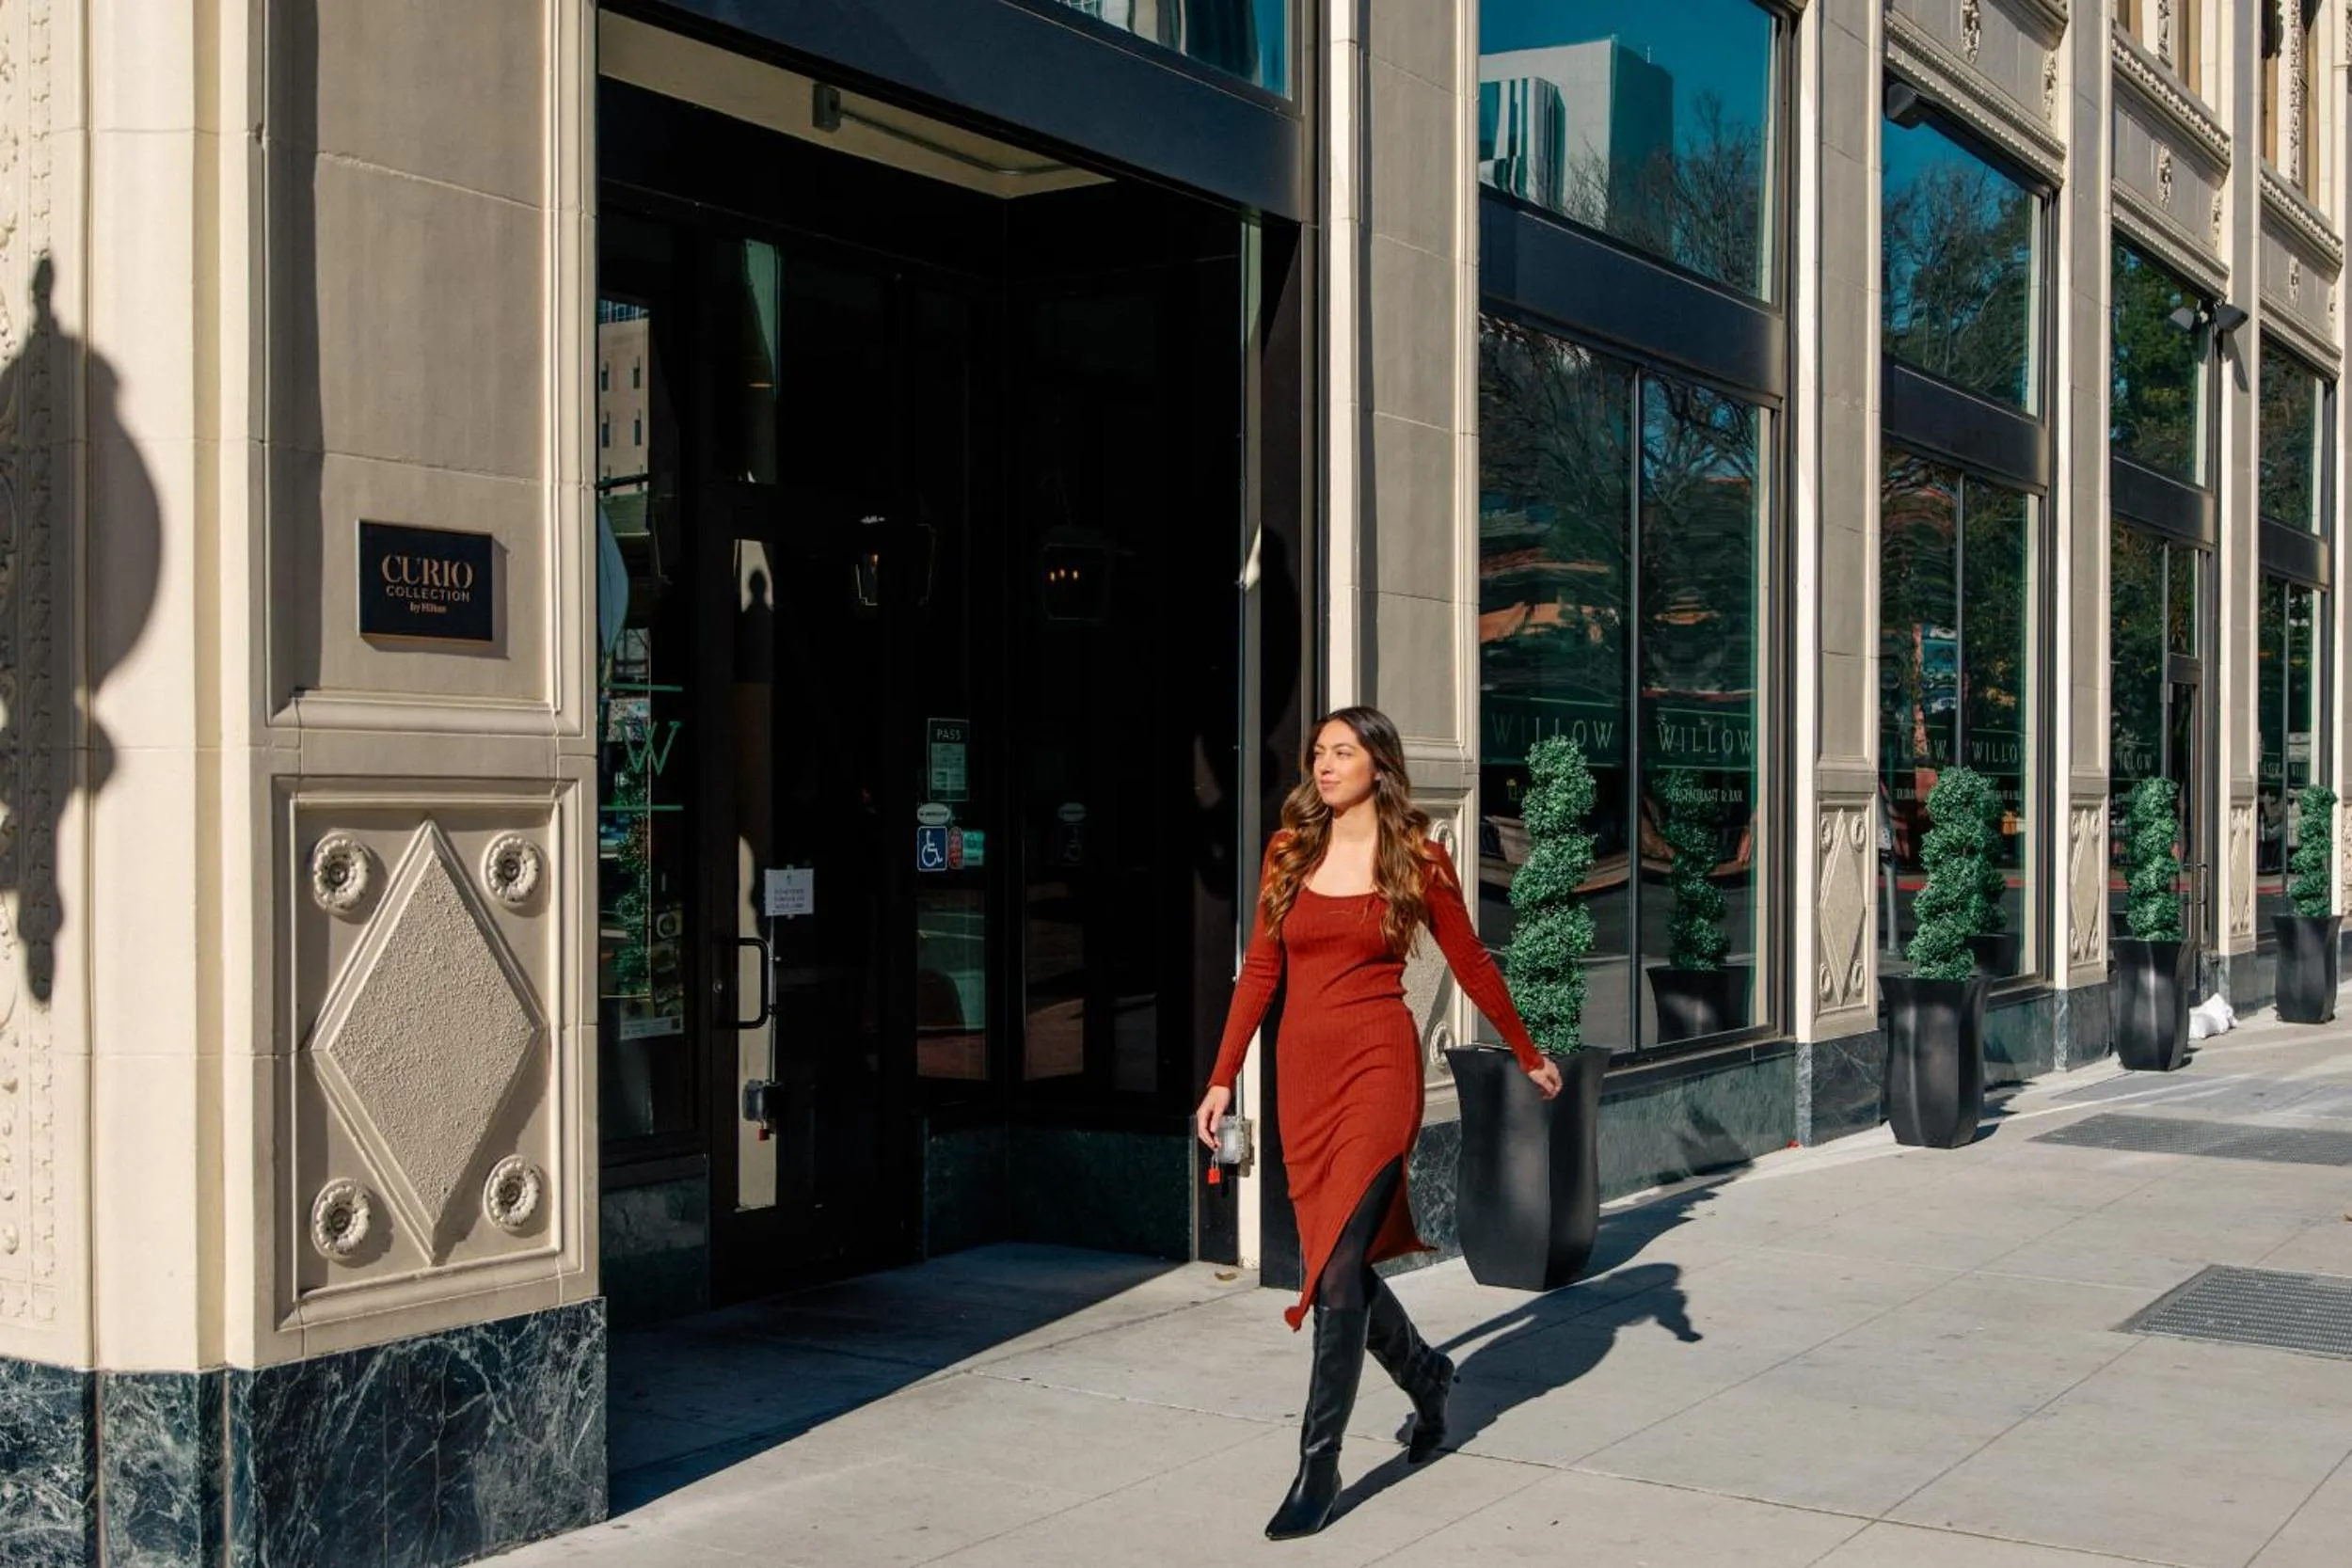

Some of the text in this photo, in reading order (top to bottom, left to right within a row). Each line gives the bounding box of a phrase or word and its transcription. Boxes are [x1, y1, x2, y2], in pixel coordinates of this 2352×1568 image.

[381, 554, 472, 589] CURIO
[386, 584, 470, 603] COLLECTION
[410, 601, 421, 614] by
[936, 728, 961, 741] PASS
[614, 720, 682, 776] W
